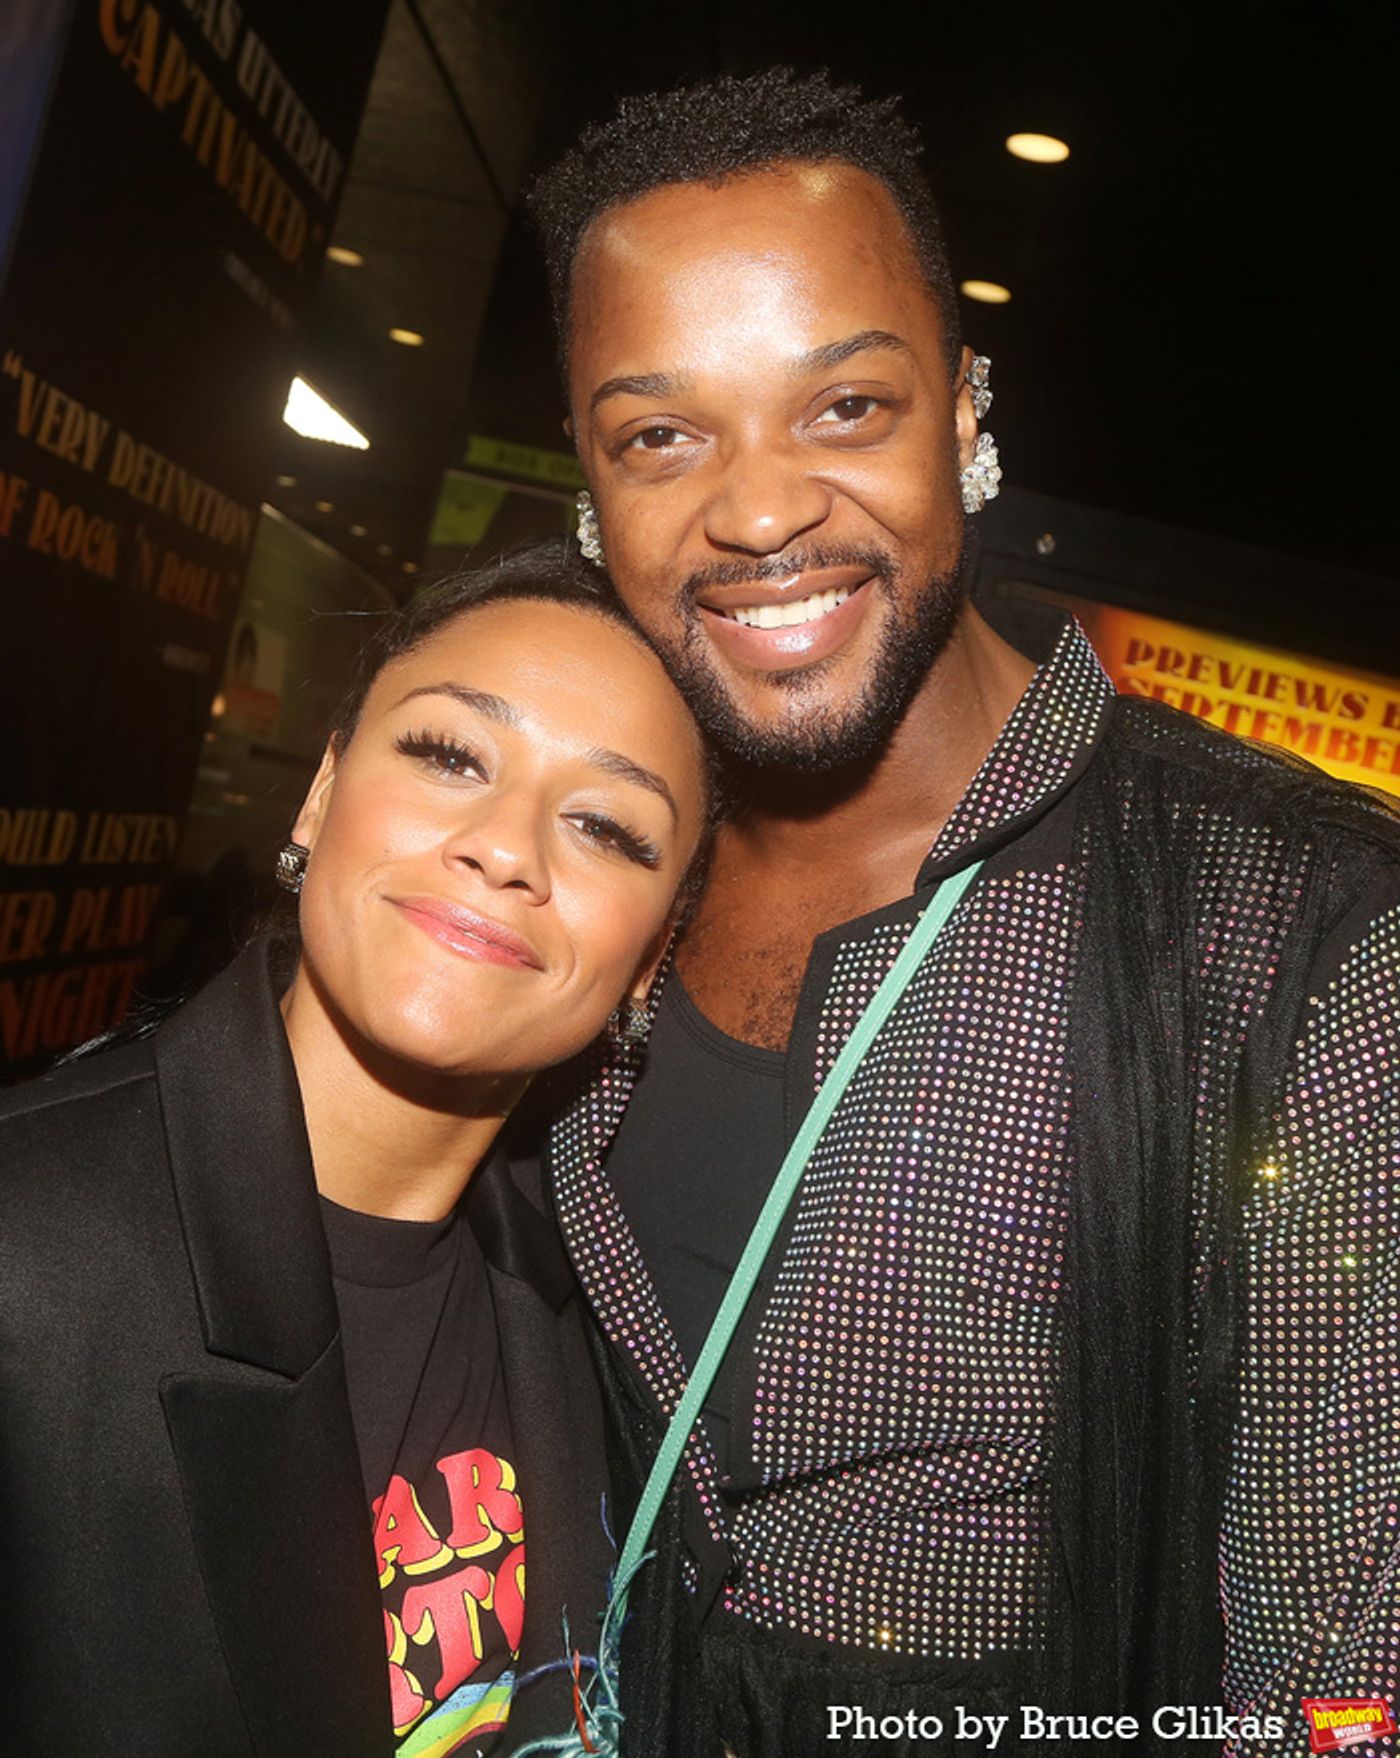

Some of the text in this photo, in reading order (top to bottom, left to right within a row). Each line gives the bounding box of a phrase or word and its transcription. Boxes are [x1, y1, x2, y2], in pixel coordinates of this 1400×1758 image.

[236, 27, 346, 204] UTTERLY
[107, 428, 252, 547] DEFINITION
[27, 488, 121, 581] ROCK
[1124, 636, 1369, 722] PREVIEWS
[60, 884, 163, 955] PLAY
